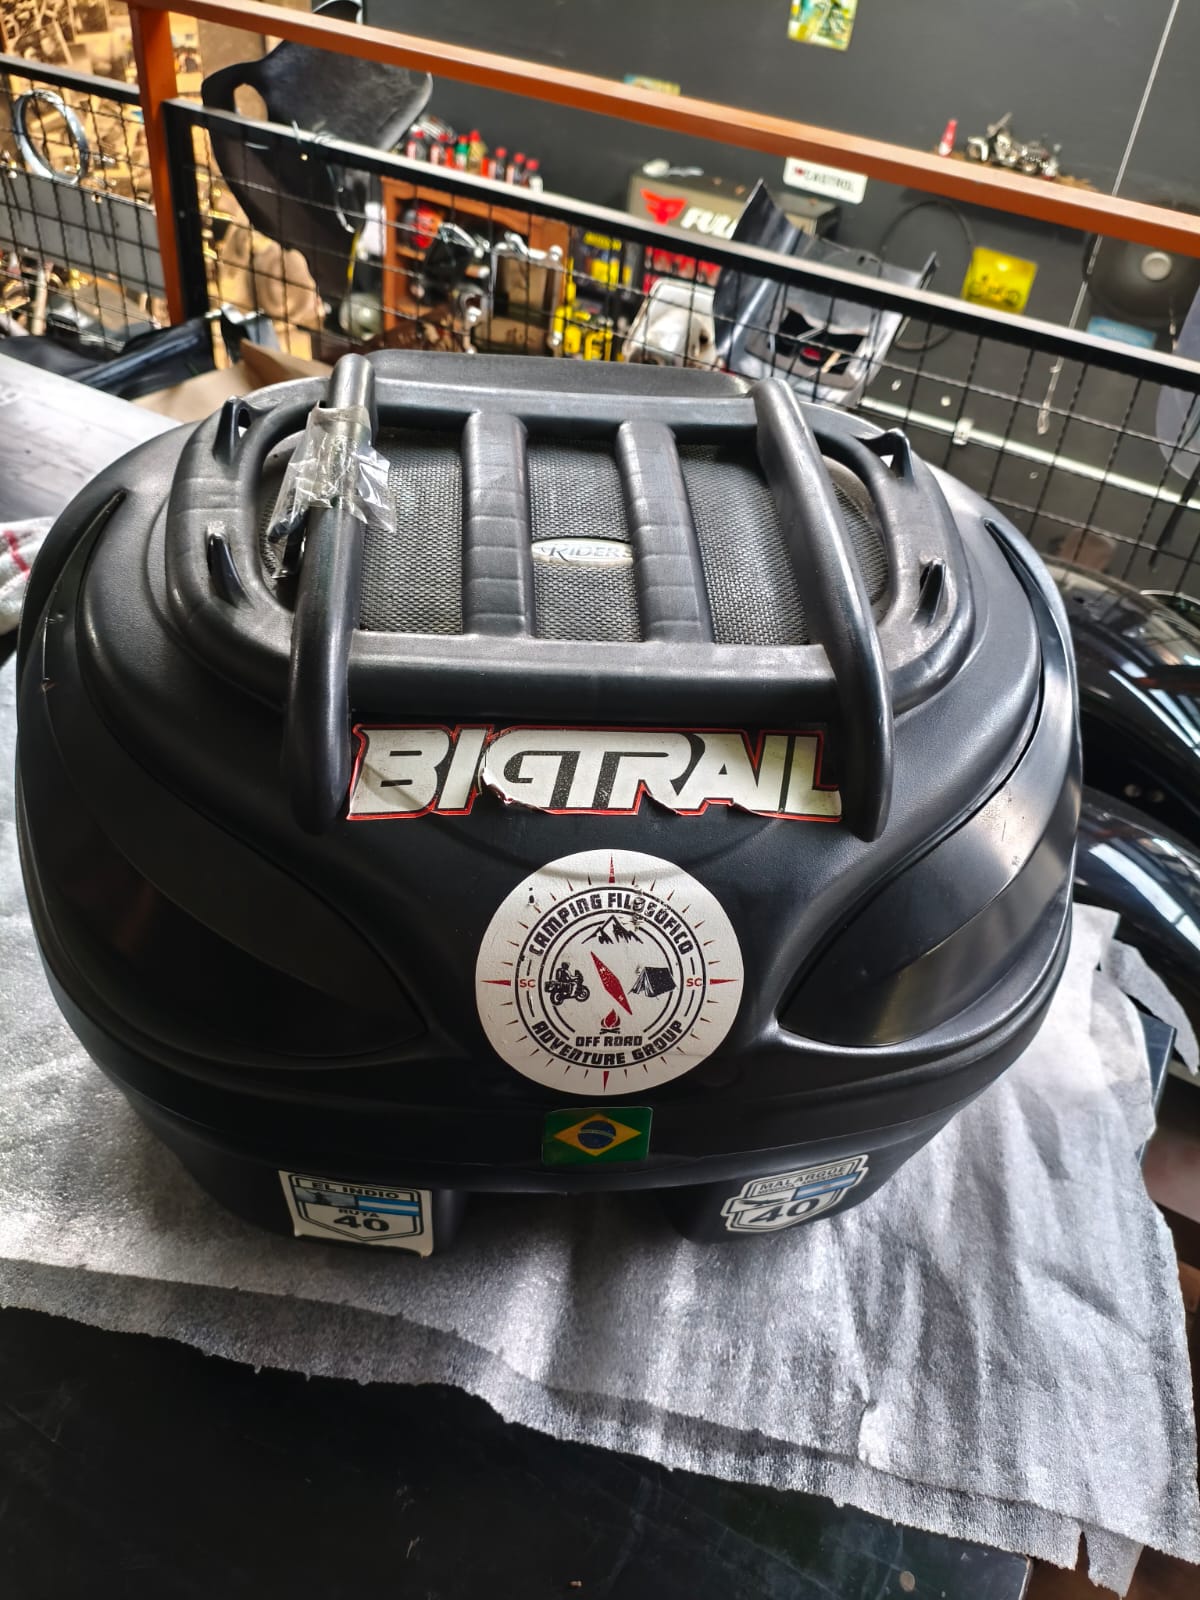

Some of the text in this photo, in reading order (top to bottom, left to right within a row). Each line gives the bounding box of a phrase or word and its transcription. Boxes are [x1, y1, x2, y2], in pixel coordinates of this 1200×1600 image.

[348, 725, 843, 819] BIGTRAIL
[529, 894, 602, 956] CAMPING
[519, 978, 537, 988] SC
[686, 977, 704, 988] SC
[532, 1020, 684, 1066] ADVENTURE GROUP
[575, 1035, 643, 1047] OFF ROAD
[312, 1182, 399, 1199] EL INDIO
[338, 1208, 380, 1218] RUTA
[748, 1197, 820, 1223] 40
[333, 1215, 389, 1232] 40
